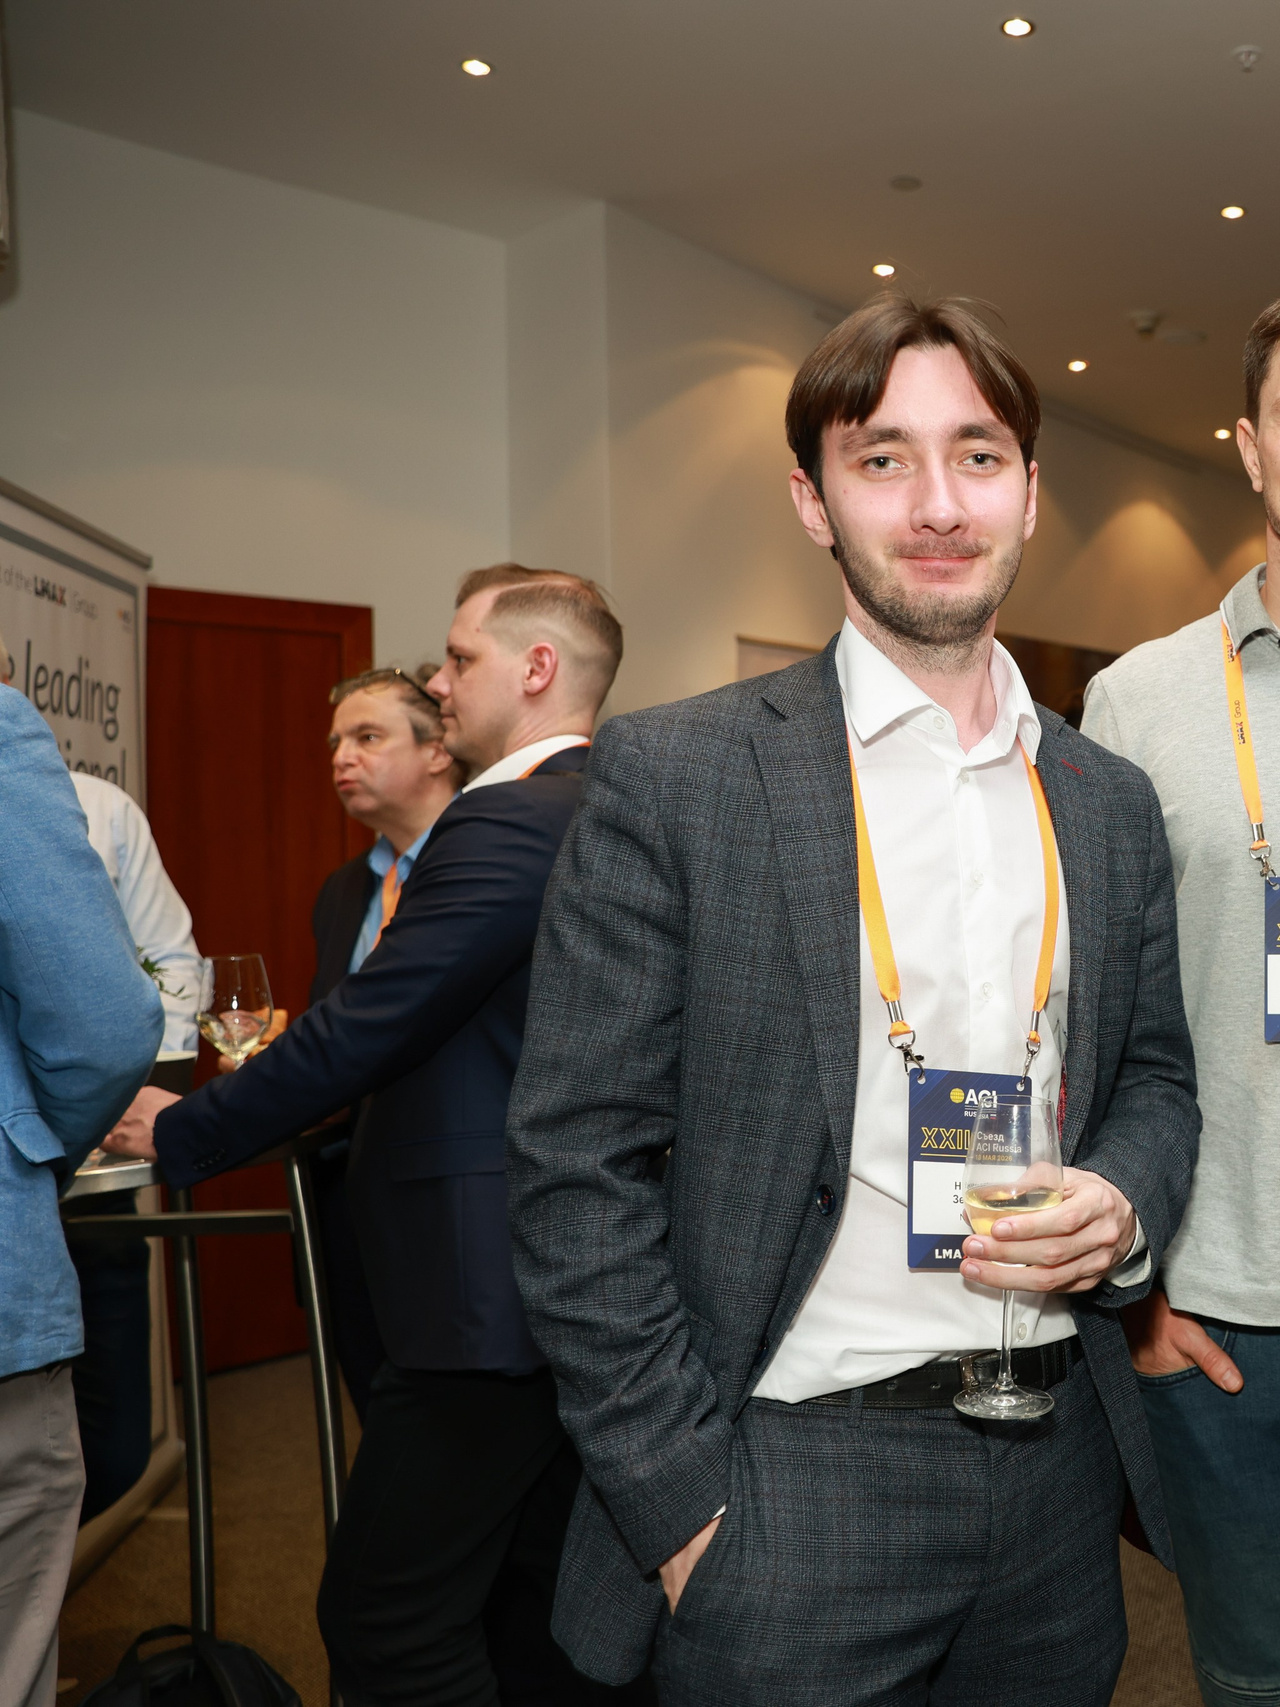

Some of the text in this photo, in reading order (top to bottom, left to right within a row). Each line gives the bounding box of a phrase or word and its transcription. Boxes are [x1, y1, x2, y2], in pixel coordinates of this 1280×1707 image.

[33, 574, 67, 608] LMAX
[24, 638, 121, 743] leading
[1233, 699, 1242, 719] Group
[964, 1088, 998, 1109] ACI
[920, 1126, 973, 1151] XXII
[976, 1131, 1005, 1143] Съезд
[976, 1142, 1022, 1154] ACI Russia
[935, 1248, 968, 1259] LMA
